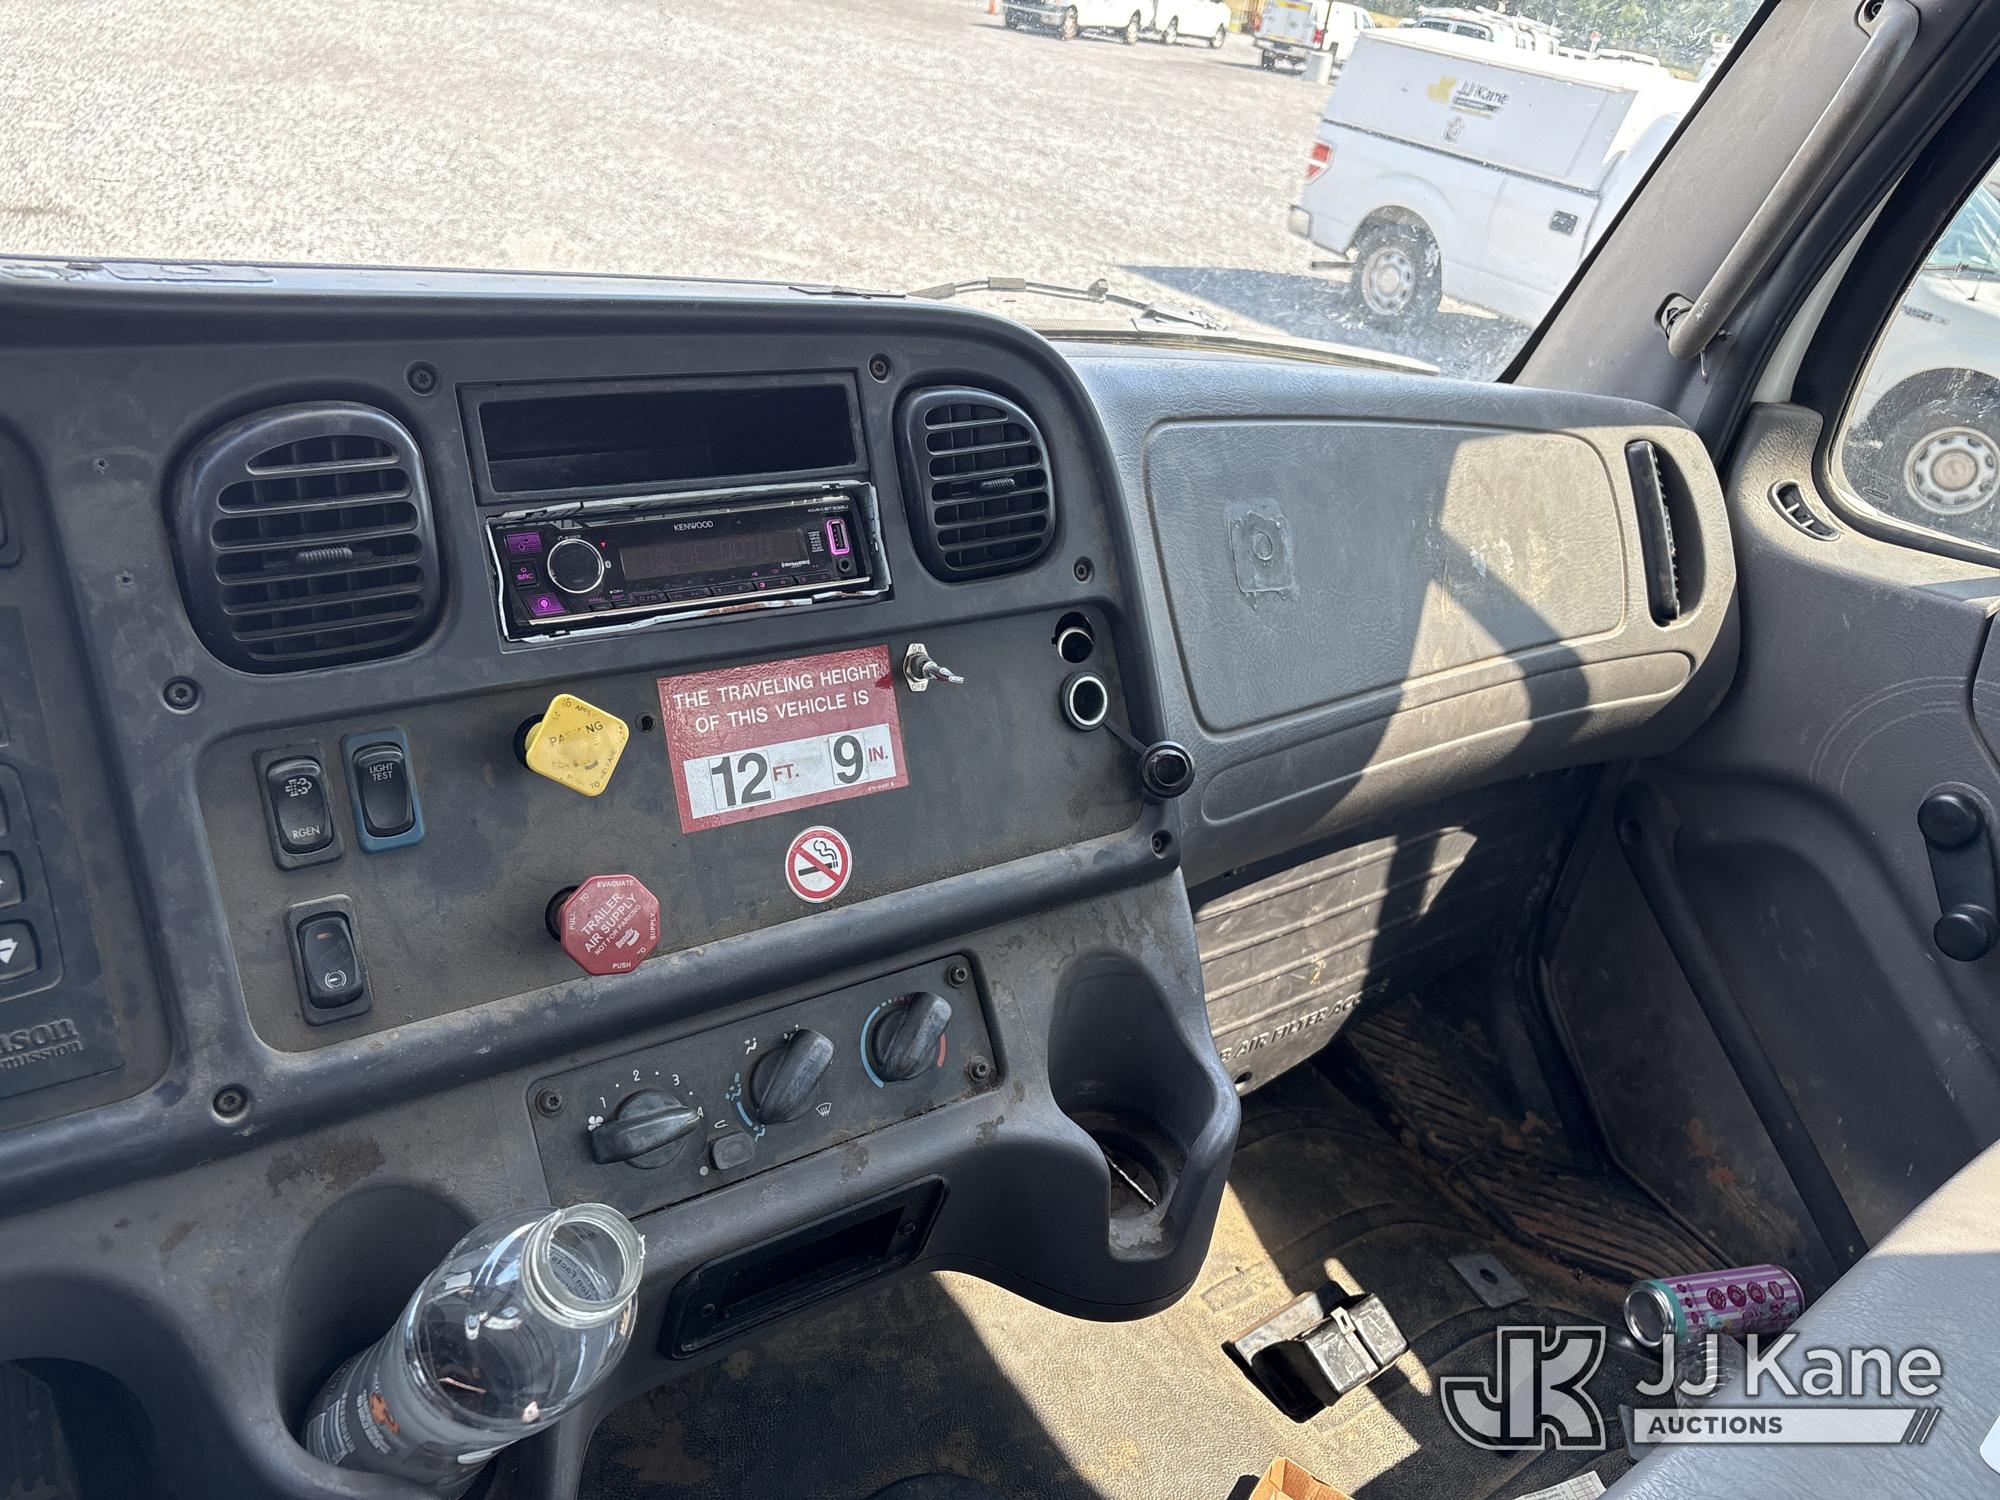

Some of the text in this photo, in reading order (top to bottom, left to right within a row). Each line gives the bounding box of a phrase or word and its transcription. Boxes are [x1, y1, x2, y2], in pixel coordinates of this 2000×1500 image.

[1474, 83, 1509, 105] Kane
[673, 520, 714, 532] KENWOOD
[673, 663, 879, 710] THE TRAVELING HEIGHT
[911, 683, 925, 691] OFF
[695, 689, 870, 734] OF THIS VEHICLE IS
[369, 762, 394, 774] LIGHT
[372, 770, 393, 782] TEST
[711, 735, 889, 807] 12 FT. 9 IN.
[292, 825, 321, 841] RGEN
[579, 892, 589, 902] TO
[581, 892, 624, 935] TRAILER
[584, 893, 637, 953] AIR SUPPLY
[594, 904, 642, 955] NOT FOR PARKING
[615, 927, 636, 949] Bendix
[612, 961, 632, 969] PUSH
[1234, 1032, 1269, 1059] AIR
[1271, 1006, 1328, 1043] FILTER
[0, 1040, 83, 1070] mission
[632, 1069, 641, 1082] 2
[671, 1073, 680, 1086] 3
